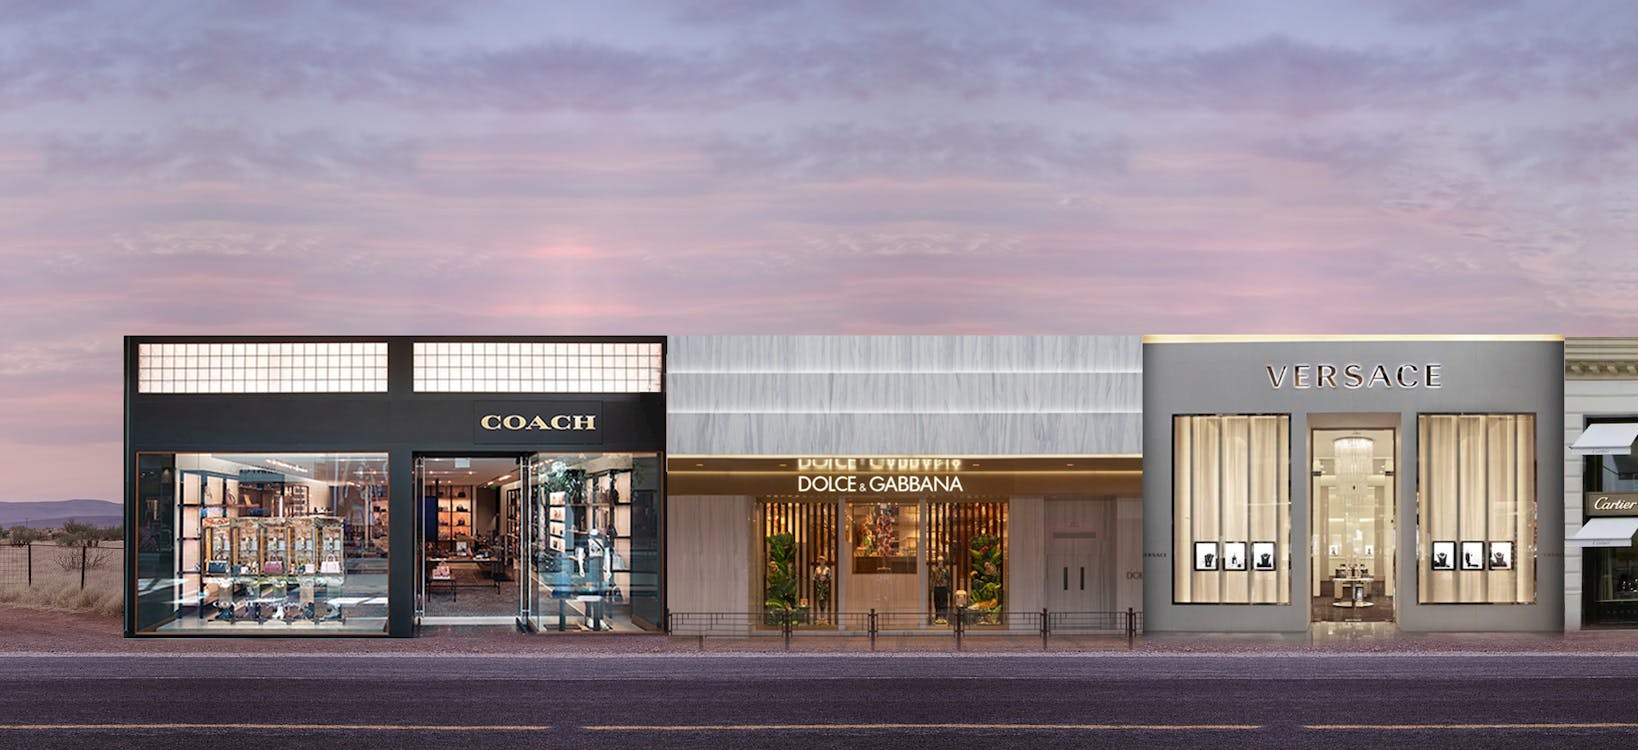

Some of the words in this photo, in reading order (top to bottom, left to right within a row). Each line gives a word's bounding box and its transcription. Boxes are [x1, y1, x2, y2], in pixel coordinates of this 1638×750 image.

[1266, 364, 1442, 389] VERSACE
[480, 414, 596, 430] COACH
[798, 476, 856, 492] DOLCE
[859, 482, 866, 492] &
[869, 475, 963, 492] GABBANA
[1594, 496, 1638, 510] Cartier
